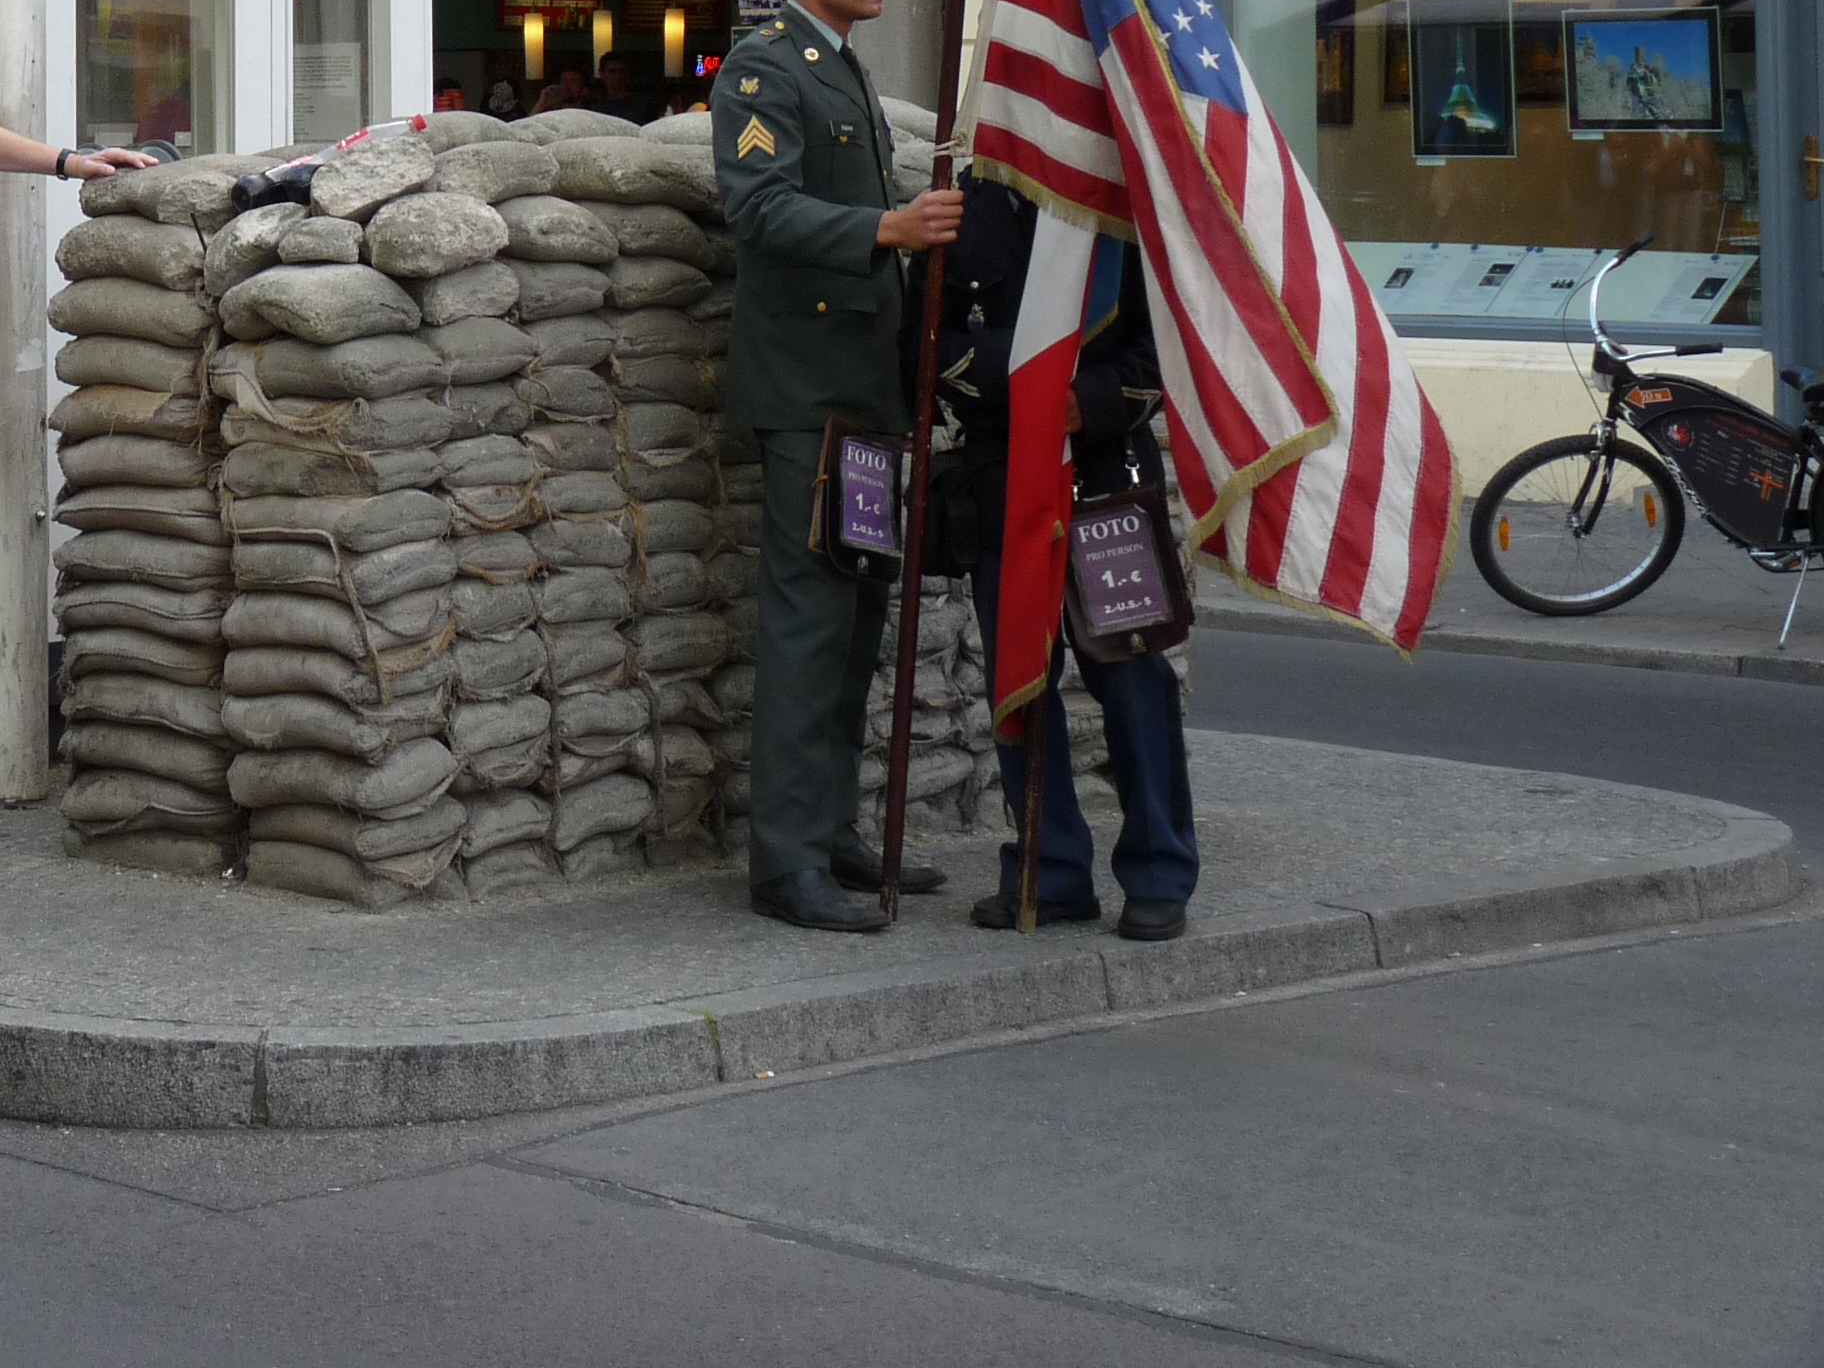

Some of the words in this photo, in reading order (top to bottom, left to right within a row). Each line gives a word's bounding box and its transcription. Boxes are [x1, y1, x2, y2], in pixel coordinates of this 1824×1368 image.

[847, 445, 887, 471] FOTO
[1077, 515, 1140, 543] FOTO
[1086, 551, 1106, 562] PRO
[1107, 543, 1144, 558] PERSON
